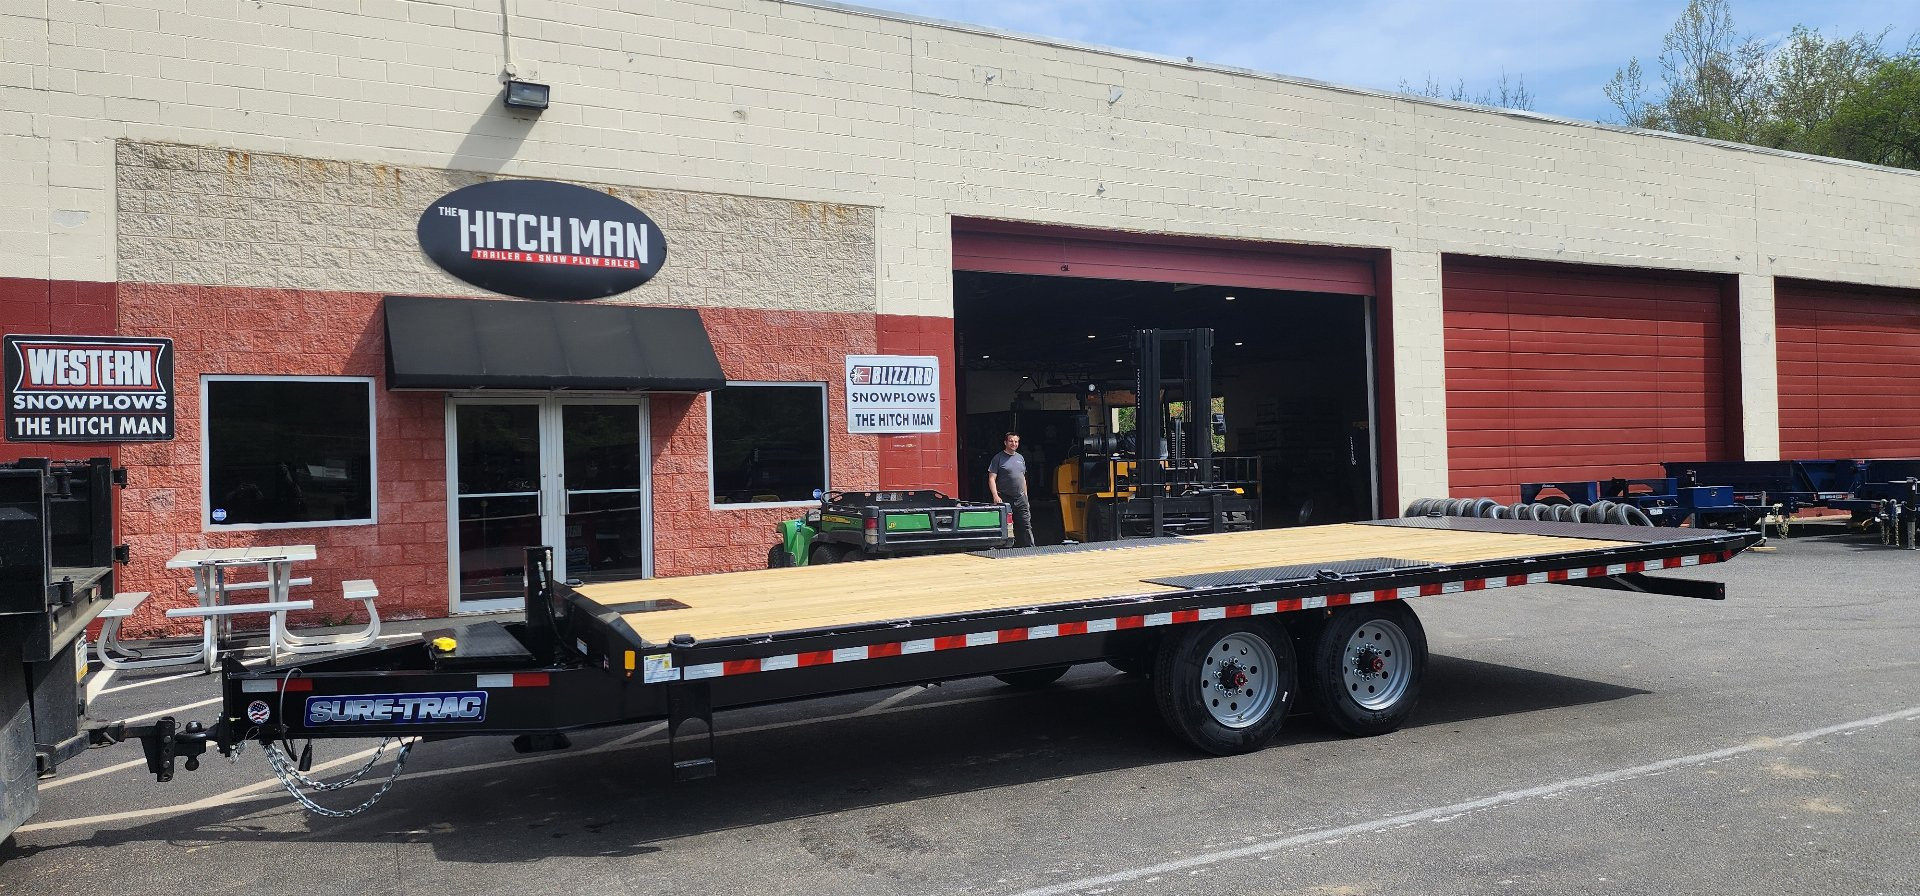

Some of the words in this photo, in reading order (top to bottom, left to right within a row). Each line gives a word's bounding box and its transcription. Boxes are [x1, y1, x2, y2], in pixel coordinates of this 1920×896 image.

[438, 206, 458, 217] THE
[458, 208, 561, 252] HITCH
[569, 217, 648, 264] MAN
[476, 250, 520, 260] TRAILER
[525, 253, 533, 262] &
[538, 254, 567, 263] SNOW
[572, 256, 600, 266] PLOW
[604, 258, 635, 268] SALES
[27, 348, 152, 386] WESTERN
[871, 366, 932, 385] BLIZZARD
[13, 395, 167, 410] SNOWPLOWS
[852, 392, 936, 403] SNOWPLOWS
[15, 417, 51, 436] THE
[57, 416, 113, 436] HITCH
[119, 416, 166, 435] MAN
[855, 413, 876, 427] THE
[878, 413, 909, 427] HITCH
[912, 413, 934, 426] MAN
[310, 696, 482, 723] SURE-TRAC
